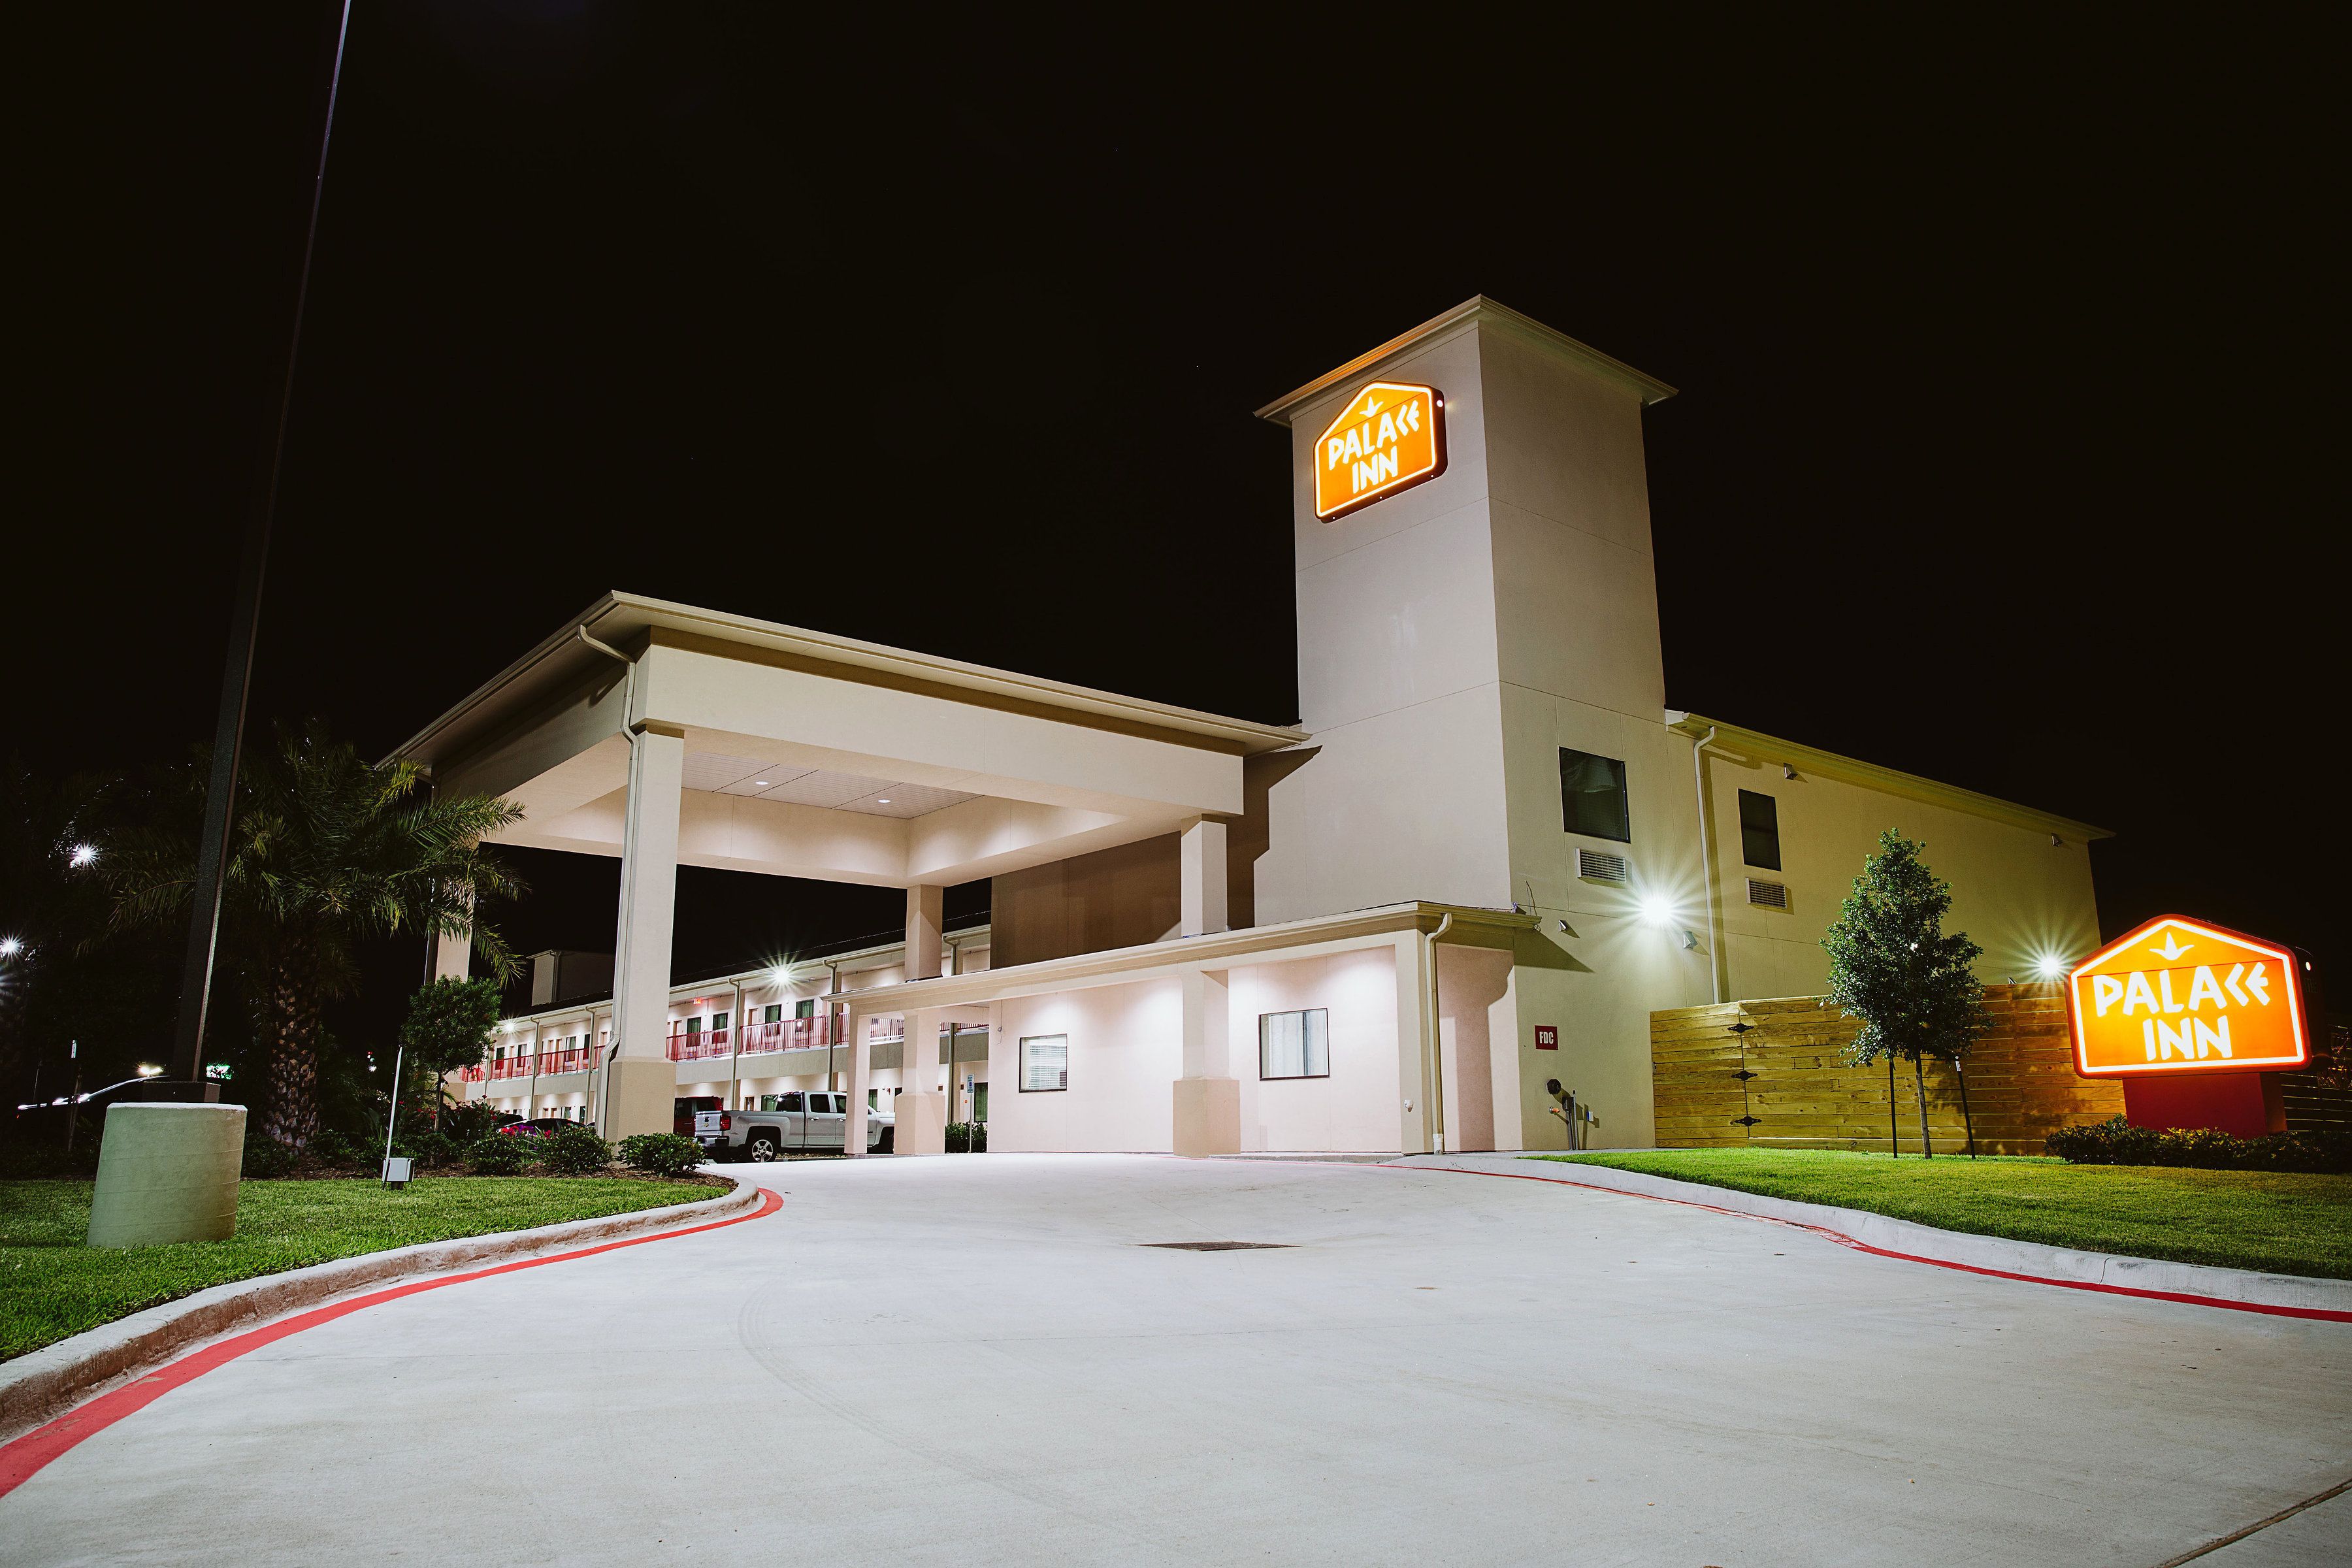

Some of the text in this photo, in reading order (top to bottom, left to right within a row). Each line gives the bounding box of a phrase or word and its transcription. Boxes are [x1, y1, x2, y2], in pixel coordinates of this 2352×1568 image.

[1328, 400, 1420, 470] PALACE
[1352, 446, 1398, 494] INN
[2093, 962, 2270, 1017] PALACE
[1539, 1031, 1554, 1045] FDC
[2142, 1015, 2232, 1062] INN
